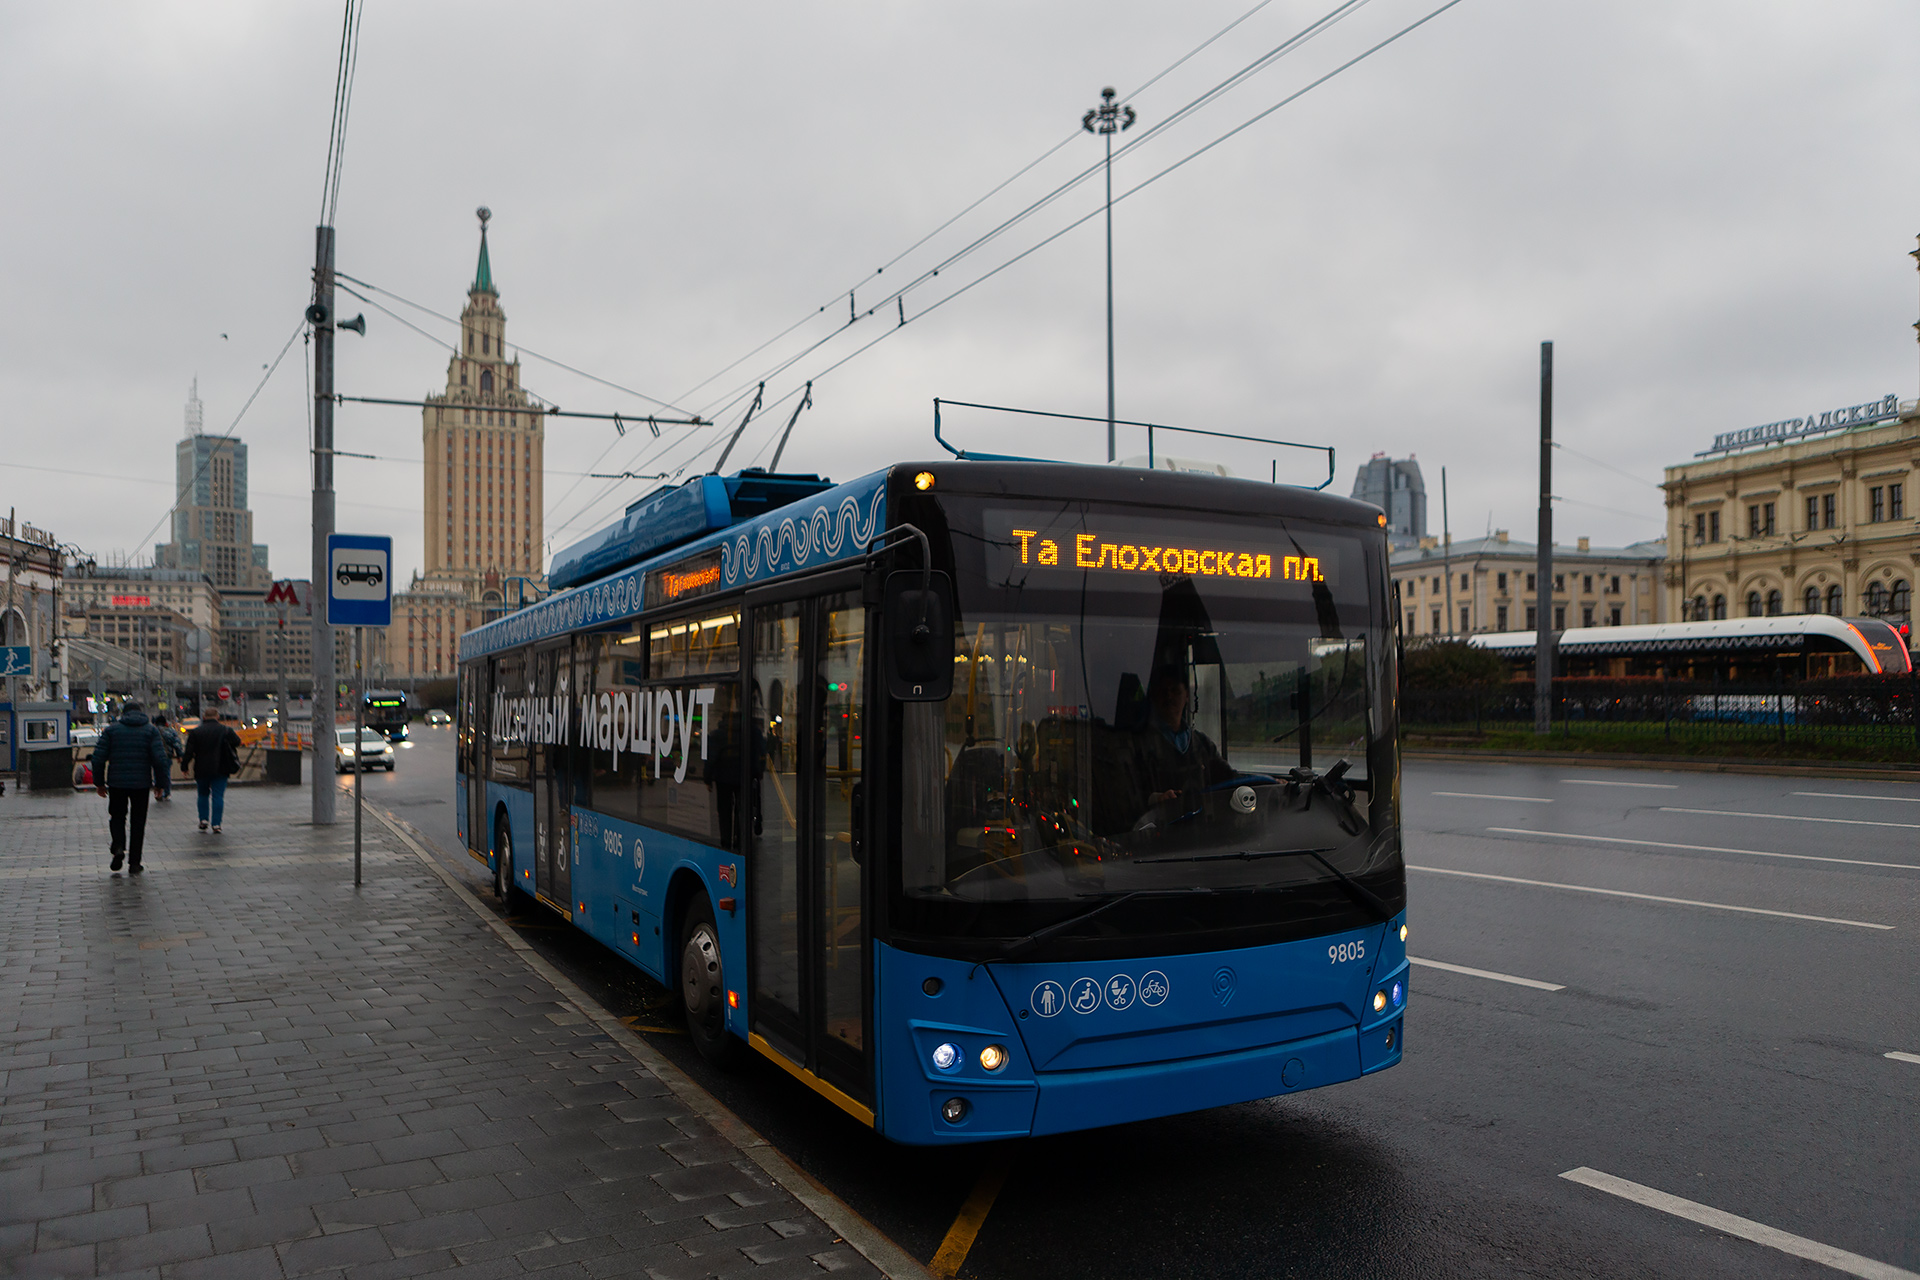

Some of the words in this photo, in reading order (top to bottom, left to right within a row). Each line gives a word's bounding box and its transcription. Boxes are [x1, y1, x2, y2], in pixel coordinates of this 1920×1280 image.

[1711, 393, 1899, 450] ЛЕНИНГРАДСКИЙ
[1012, 528, 1058, 566] Та
[1075, 533, 1271, 578] Елоховская
[1284, 555, 1324, 582] пл.
[491, 676, 569, 756] Музейный
[579, 687, 716, 784] маршрут
[603, 828, 623, 858] 9805
[1328, 939, 1365, 965] 9805
